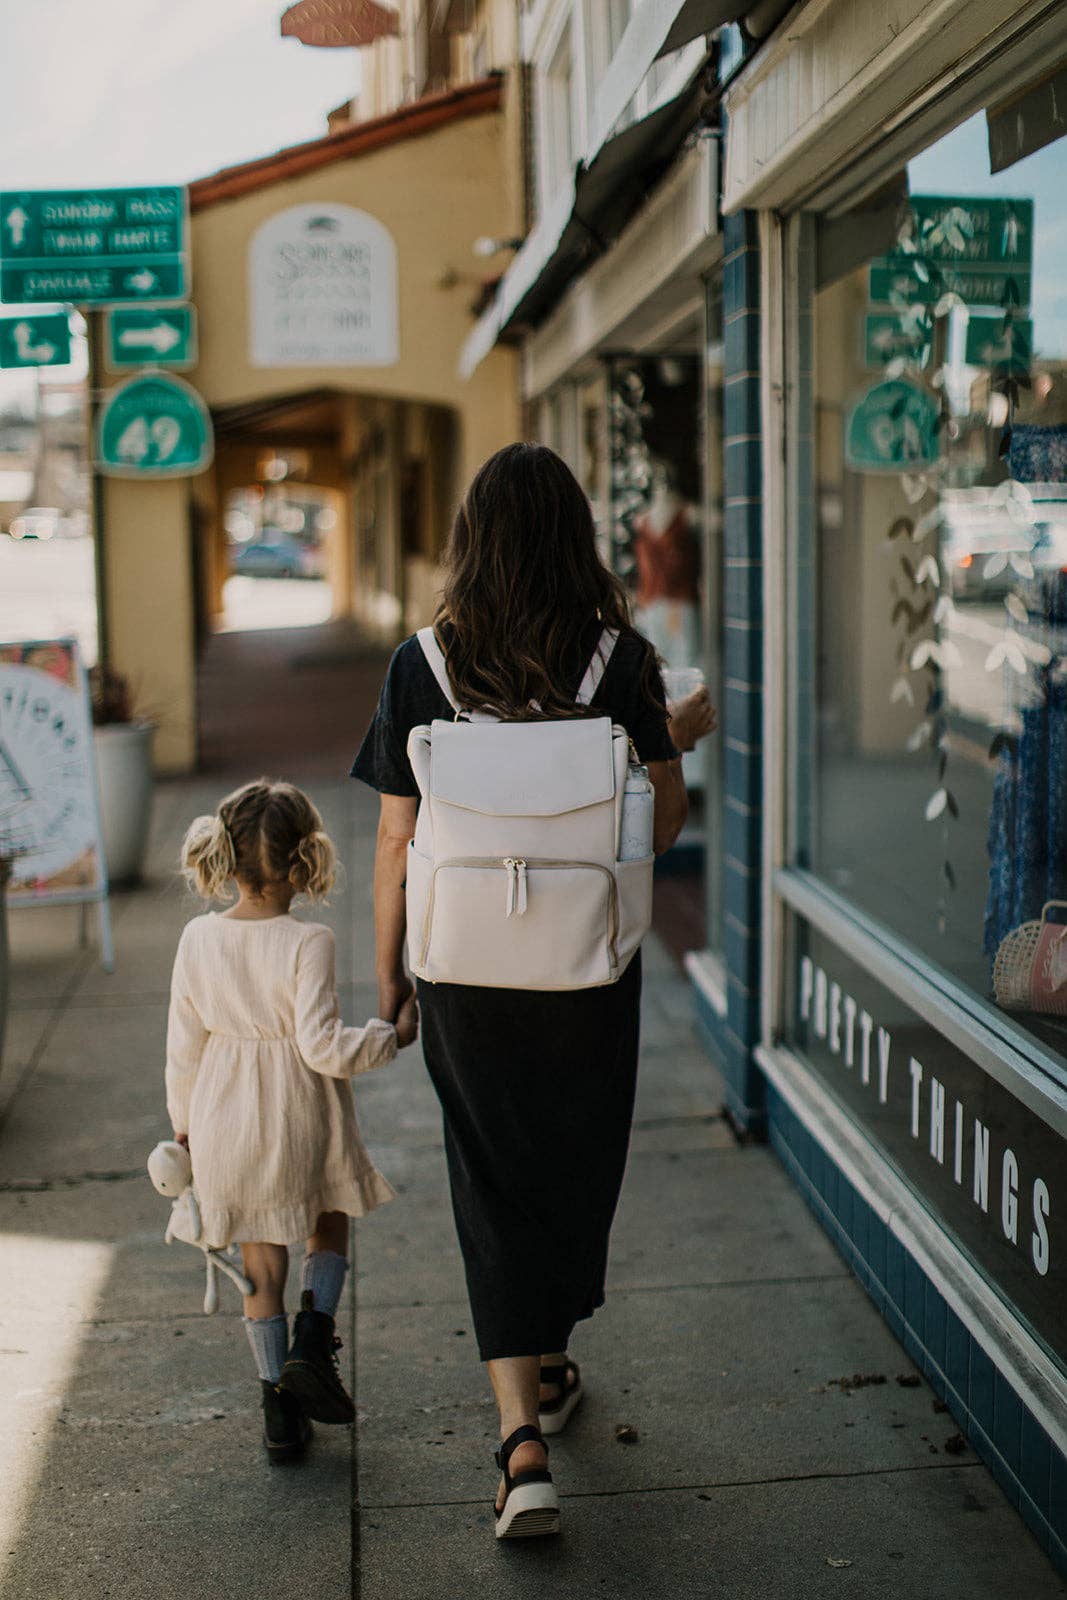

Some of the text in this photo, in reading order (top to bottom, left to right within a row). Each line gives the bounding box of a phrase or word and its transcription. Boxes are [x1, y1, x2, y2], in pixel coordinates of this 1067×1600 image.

[116, 415, 181, 462] 49
[801, 955, 1050, 1277] PRETTY THINGS
